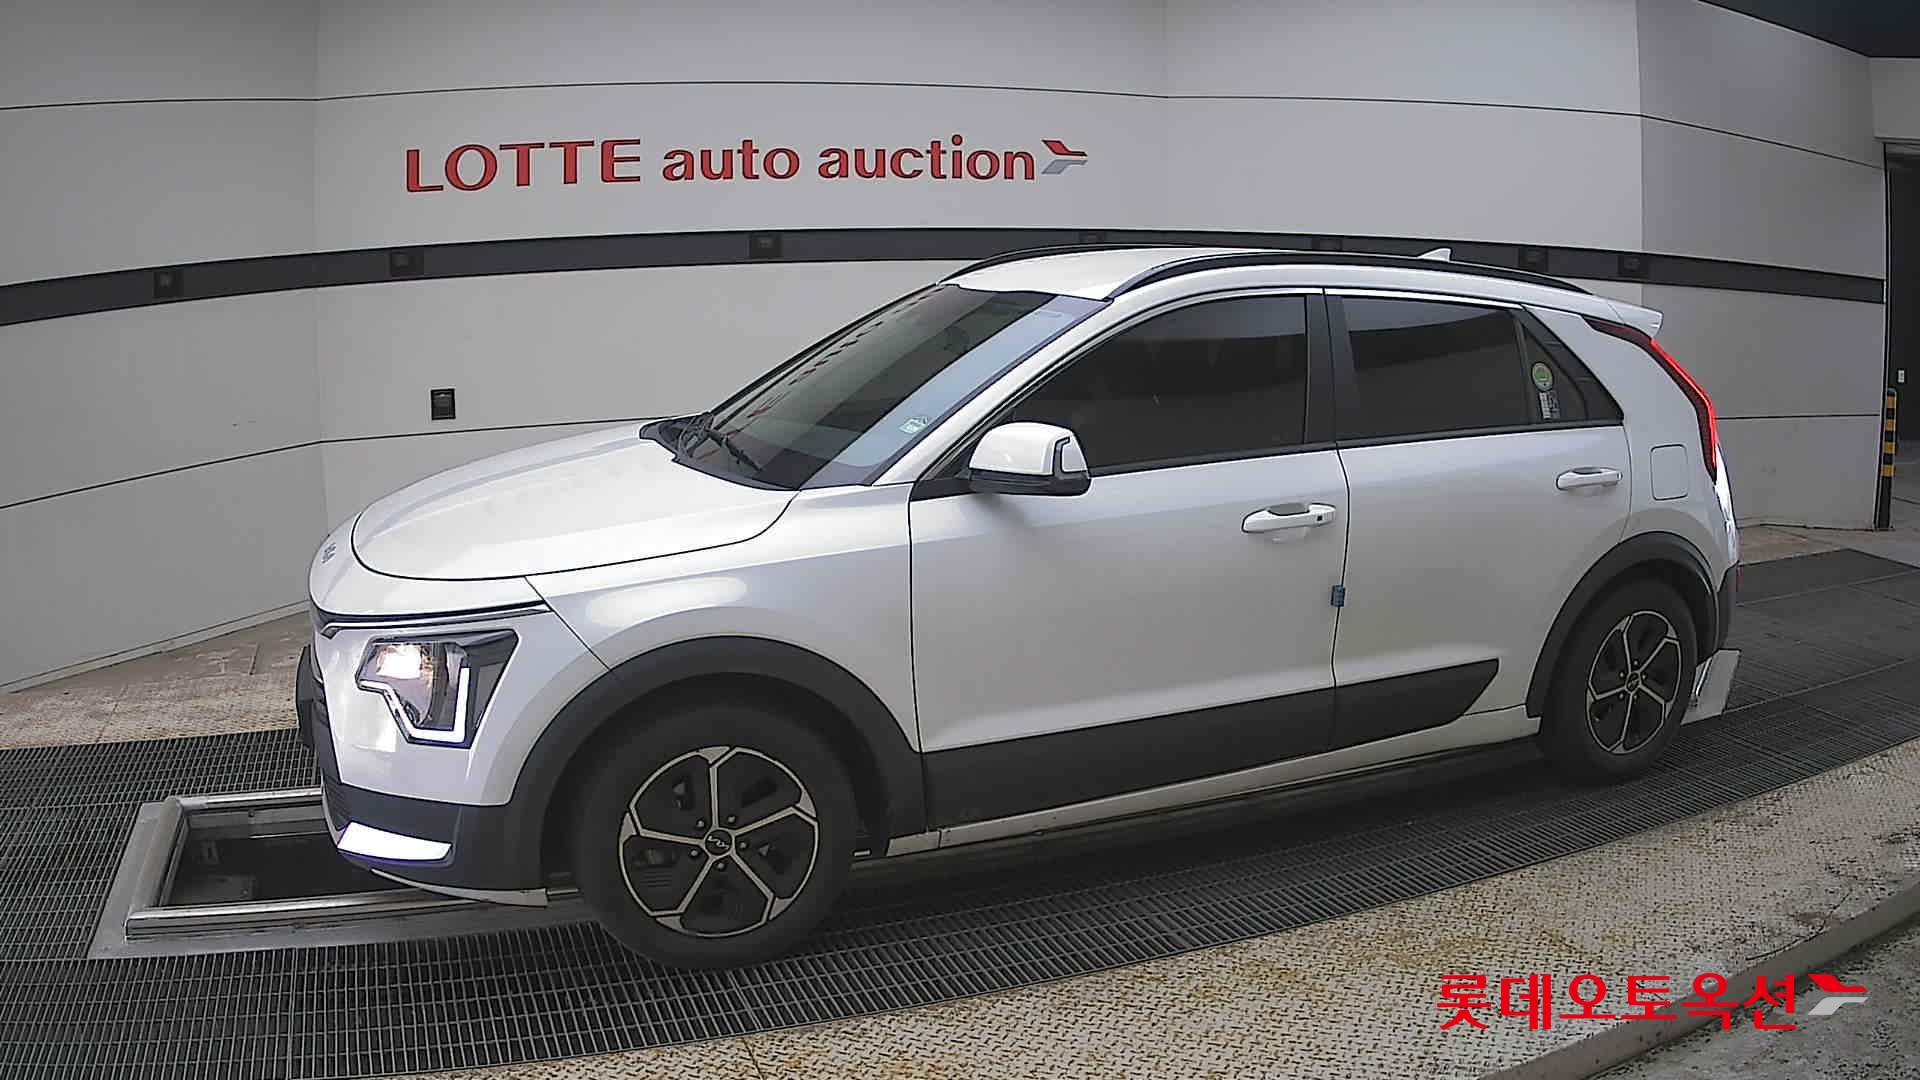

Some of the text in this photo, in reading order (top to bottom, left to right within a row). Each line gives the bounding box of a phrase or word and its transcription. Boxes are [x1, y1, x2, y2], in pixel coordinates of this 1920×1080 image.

[405, 134, 1036, 193] LOTTE auto auction
